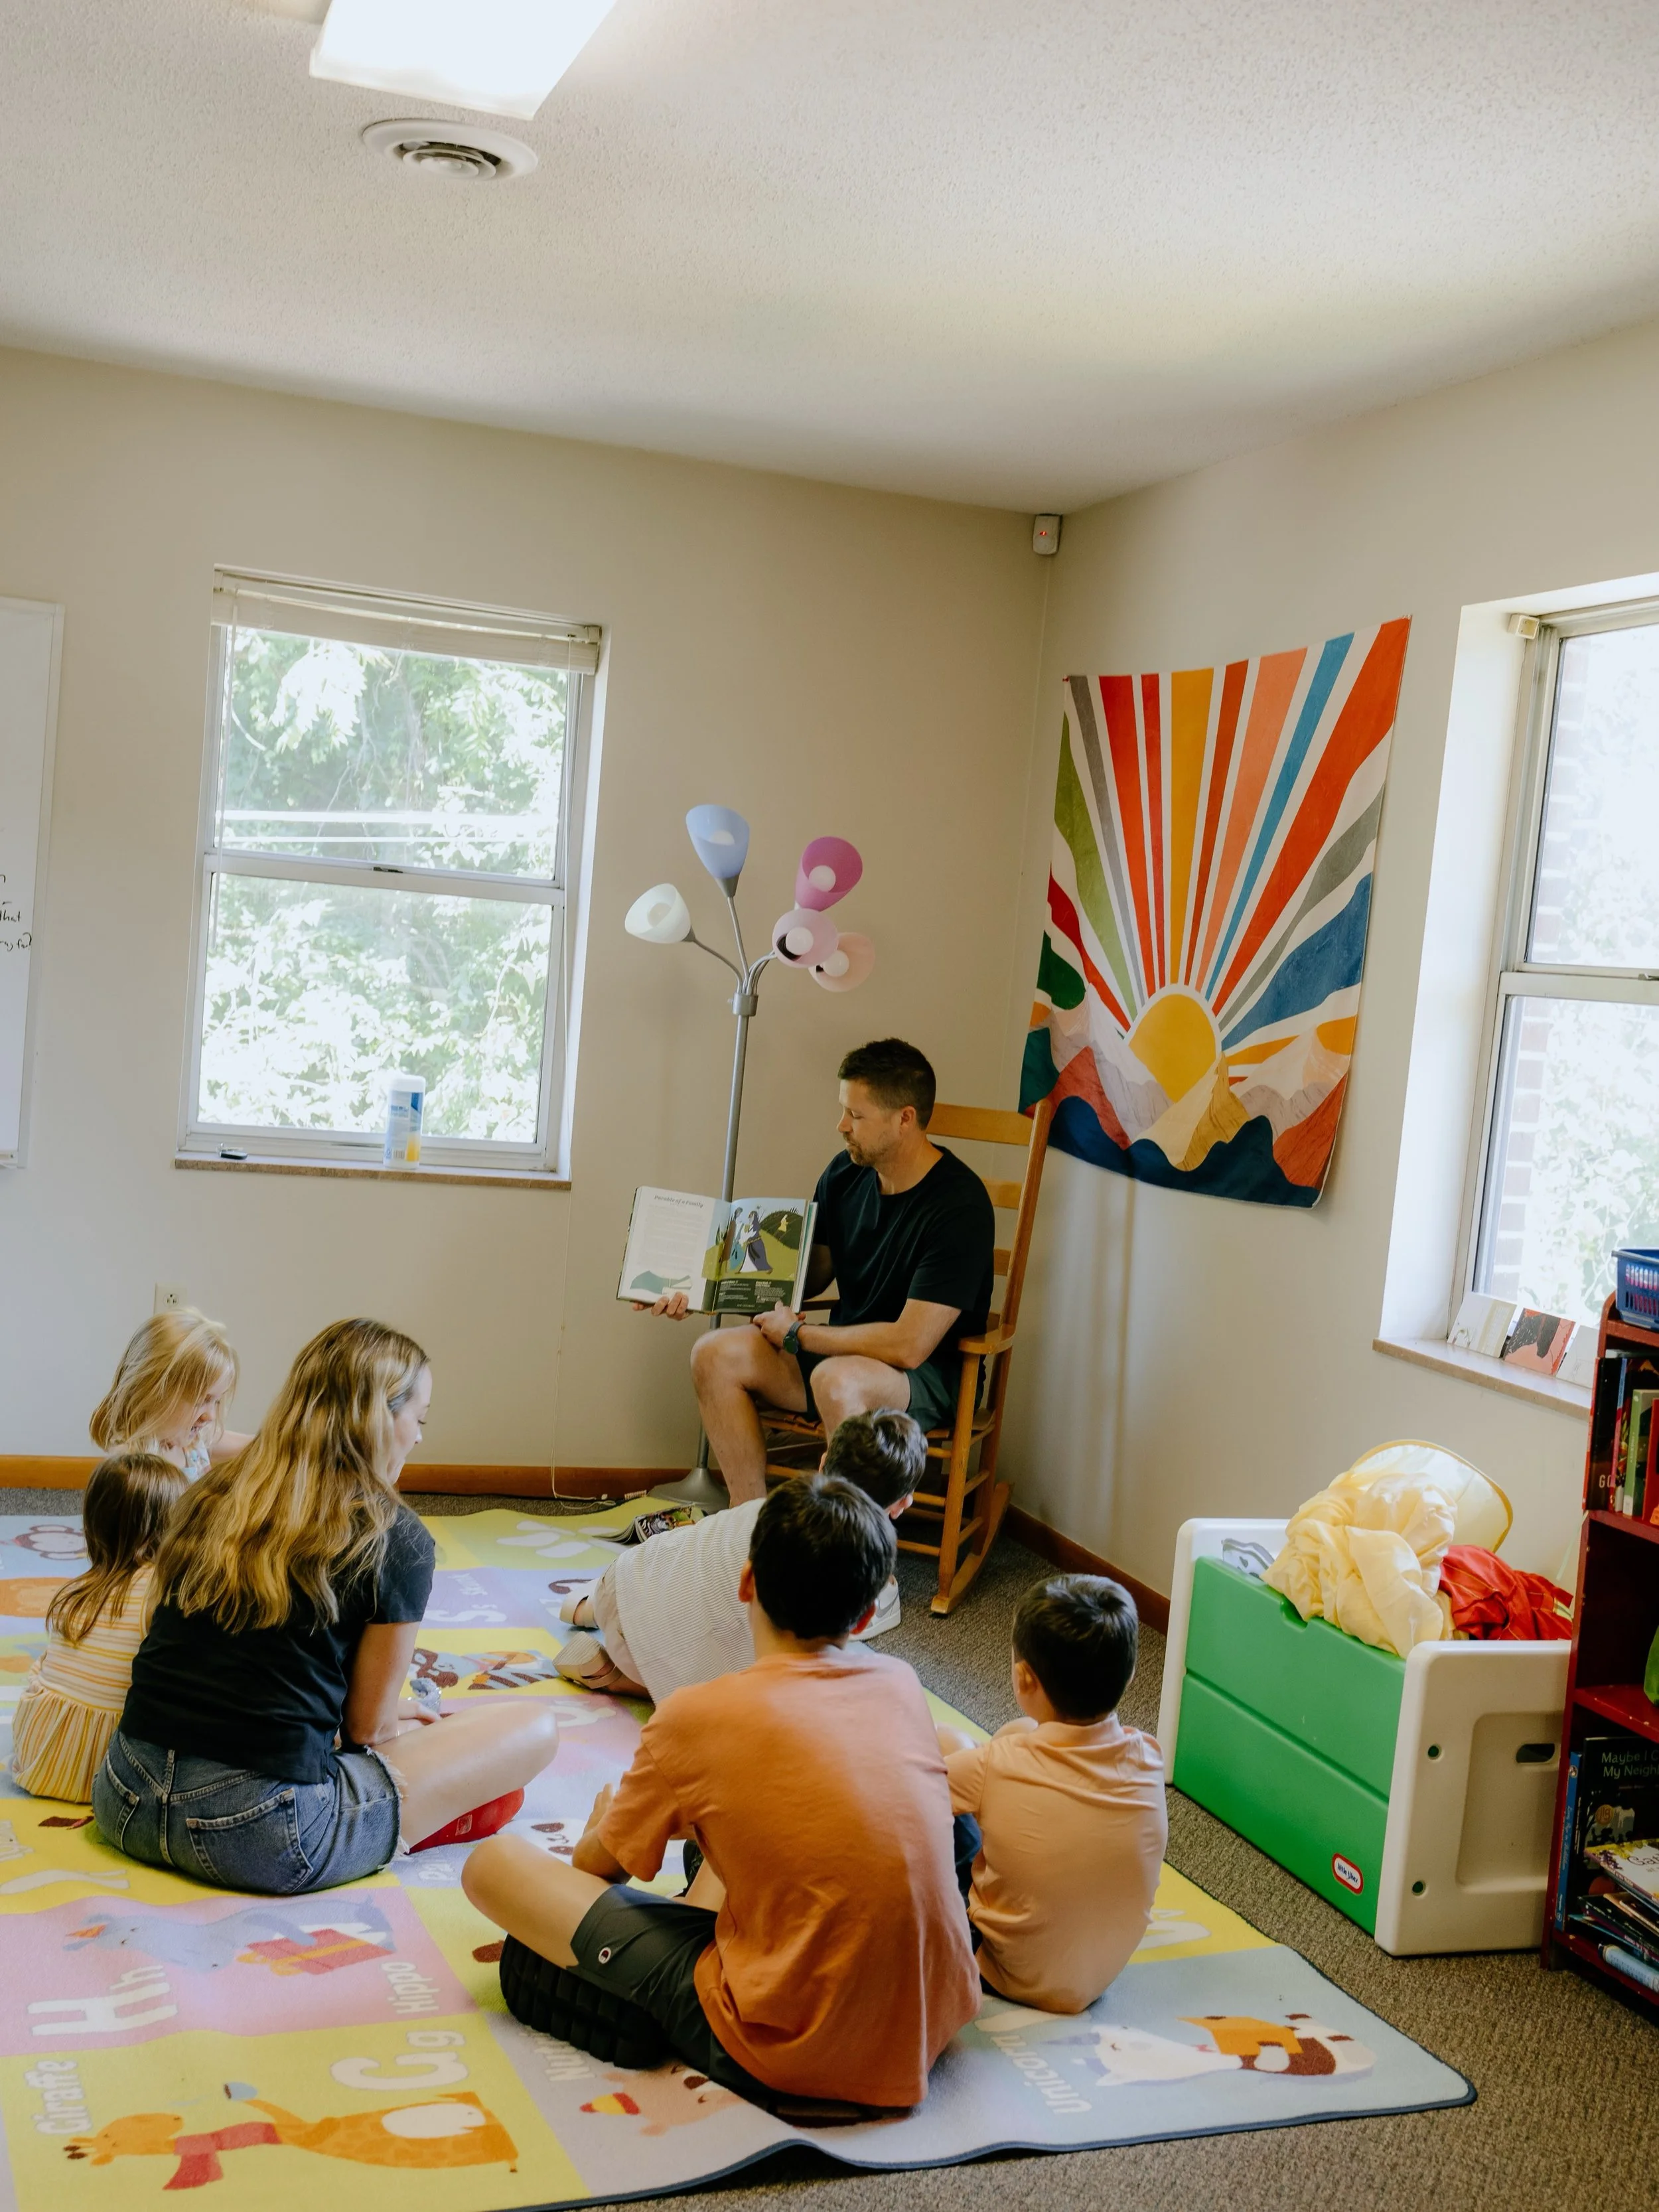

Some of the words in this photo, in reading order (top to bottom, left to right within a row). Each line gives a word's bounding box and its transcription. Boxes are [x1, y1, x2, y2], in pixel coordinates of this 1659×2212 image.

[1601, 1749, 1640, 1765] Maybe
[1644, 1749, 1648, 1761] I
[1603, 1765, 1621, 1780] My
[380, 1961, 440, 2014] Hippo
[23, 2059, 92, 2136] Giraffe
[990, 2035, 1092, 2115] Unicorn
